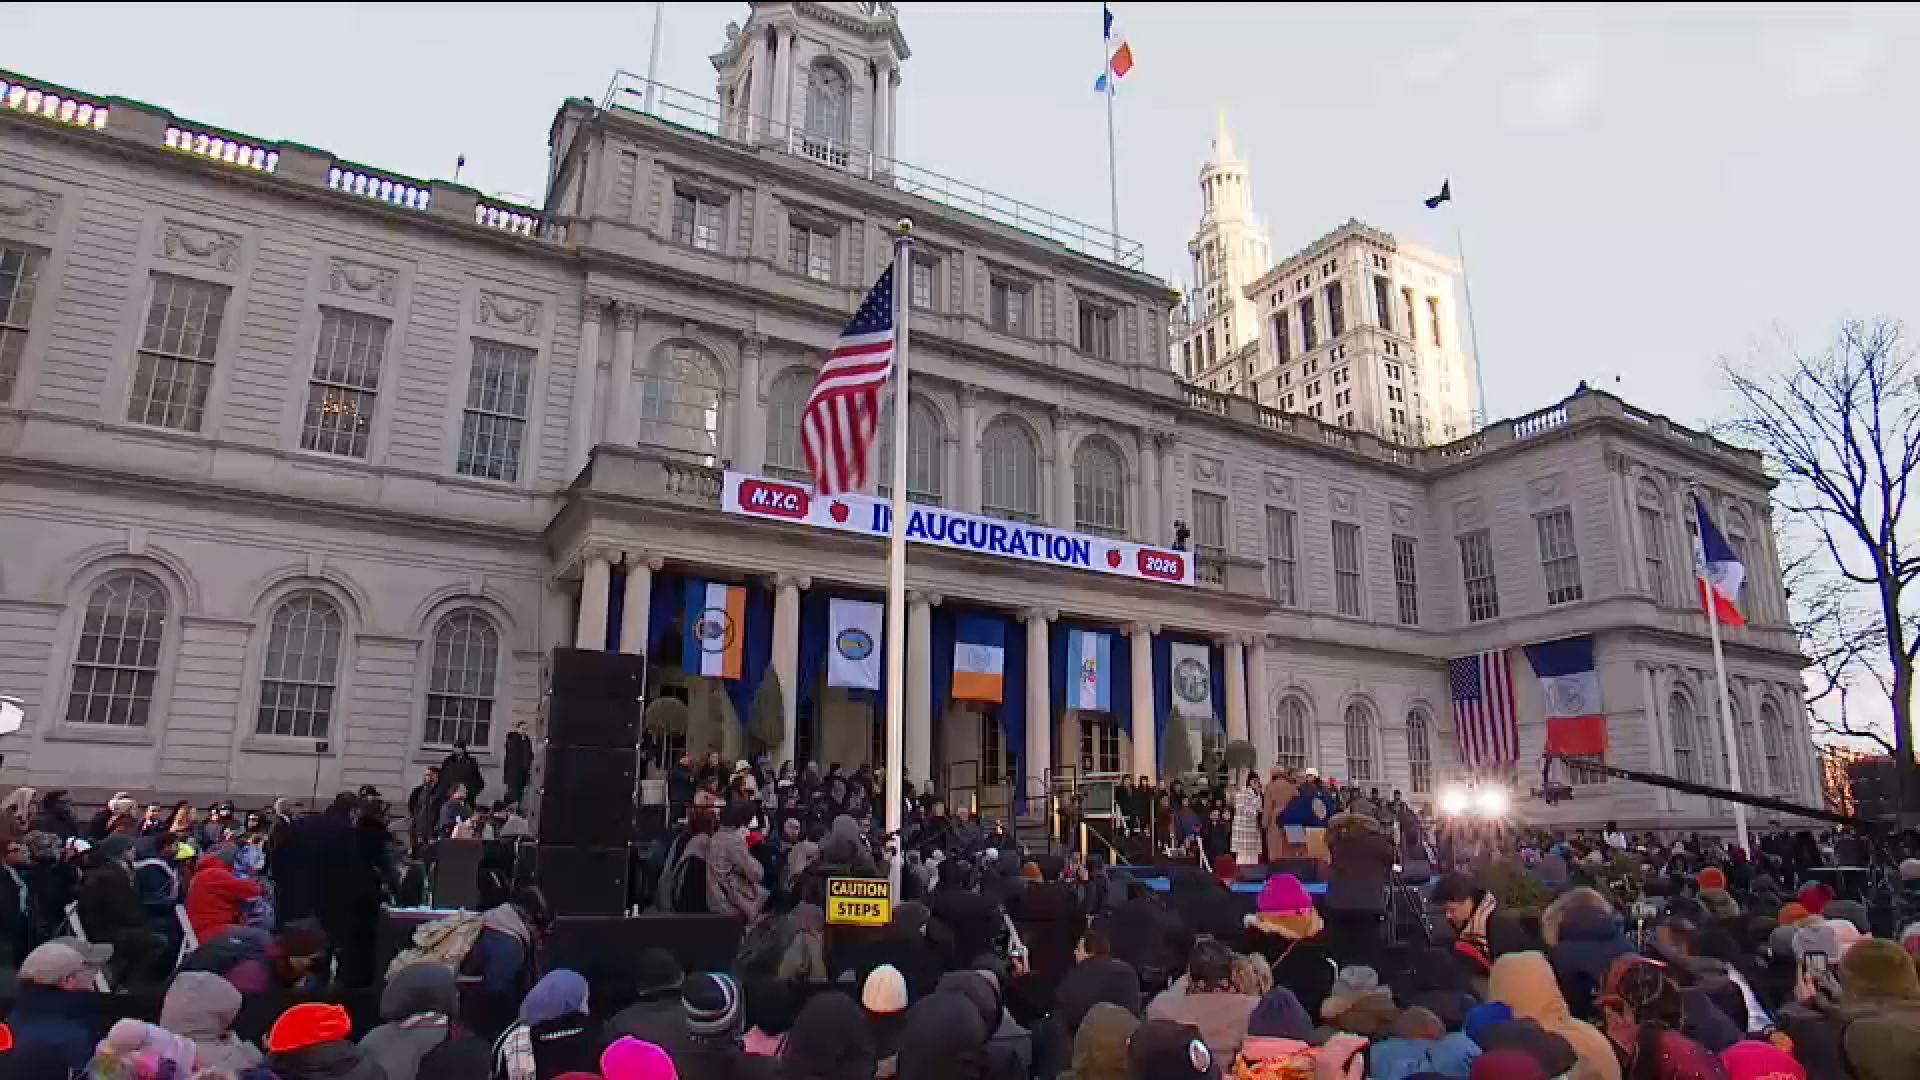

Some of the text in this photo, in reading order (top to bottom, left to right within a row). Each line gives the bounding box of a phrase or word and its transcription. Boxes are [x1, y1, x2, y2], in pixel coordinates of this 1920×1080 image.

[751, 486, 799, 511] N.Y.C.
[1145, 556, 1177, 574] 2026
[832, 881, 887, 897] CAUTION
[838, 902, 881, 916] STEPS
